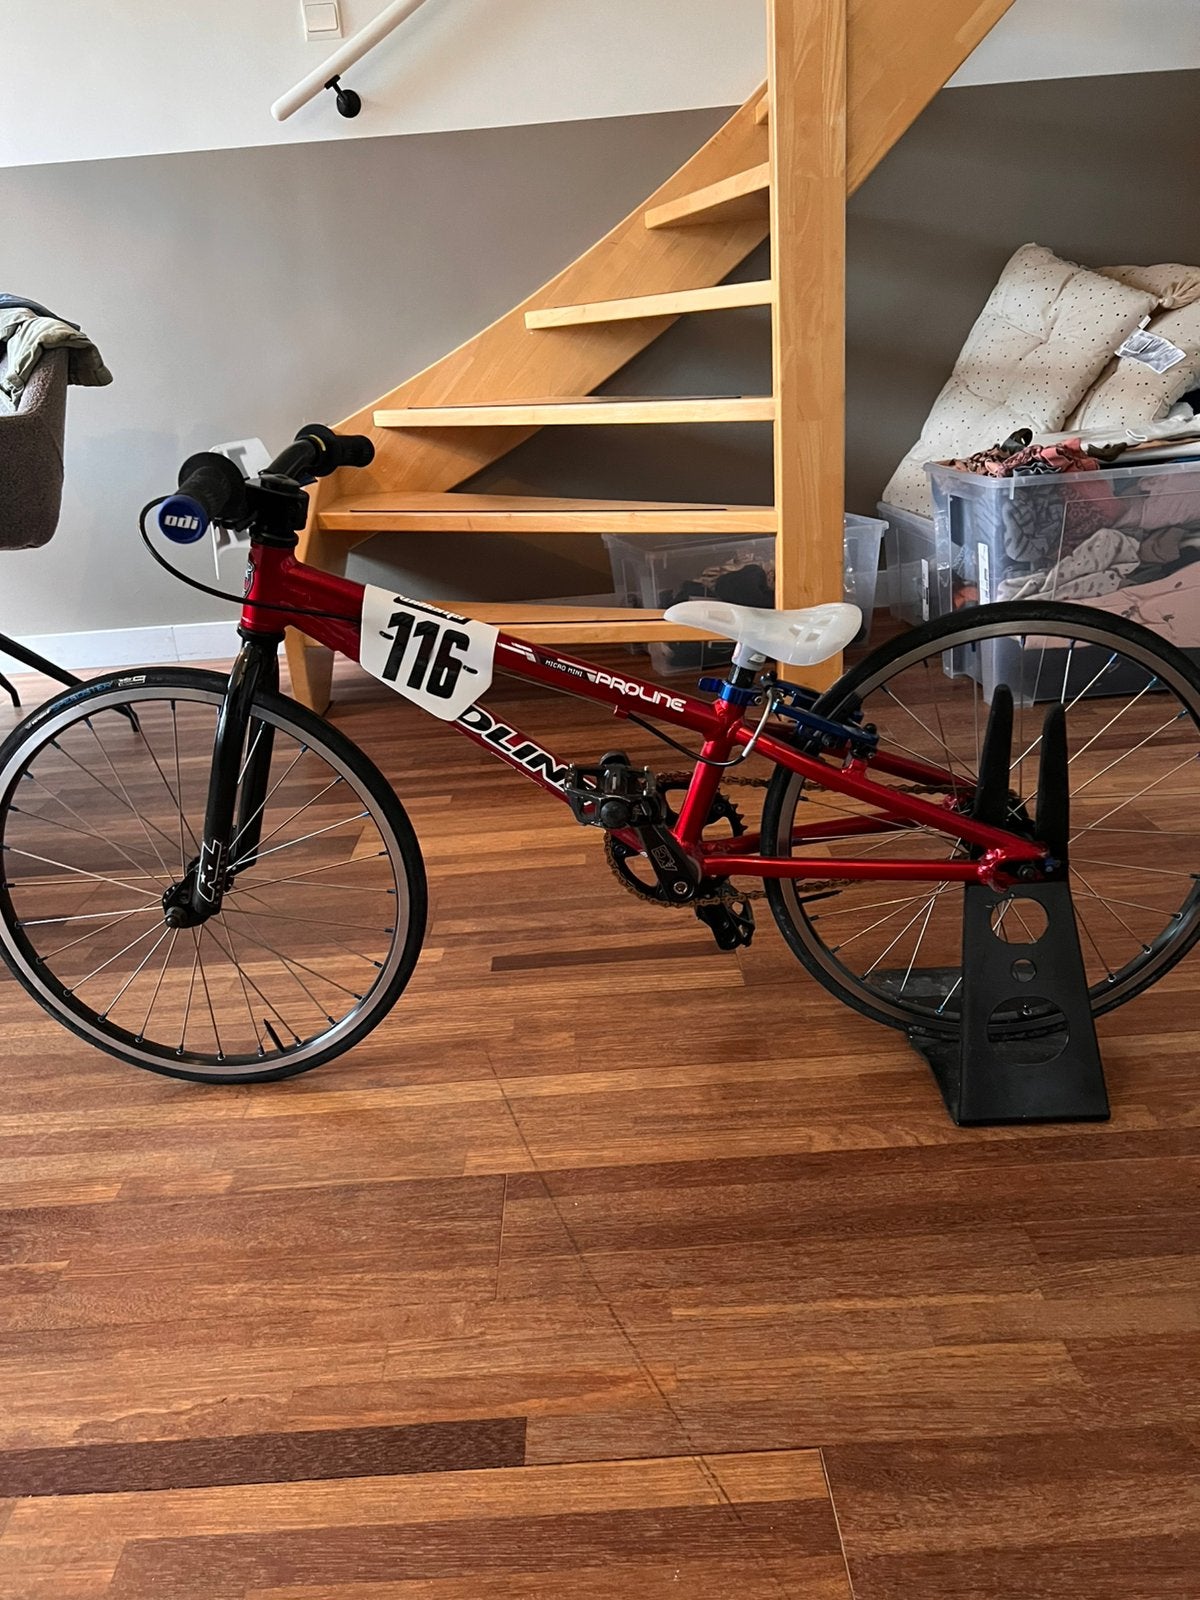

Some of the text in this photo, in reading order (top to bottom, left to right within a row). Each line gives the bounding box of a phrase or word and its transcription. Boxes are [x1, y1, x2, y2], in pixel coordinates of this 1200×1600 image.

[382, 611, 470, 699] 116
[545, 659, 583, 678] MICRO MINI
[595, 671, 687, 713] PROLINE
[455, 703, 570, 793] DLIN
